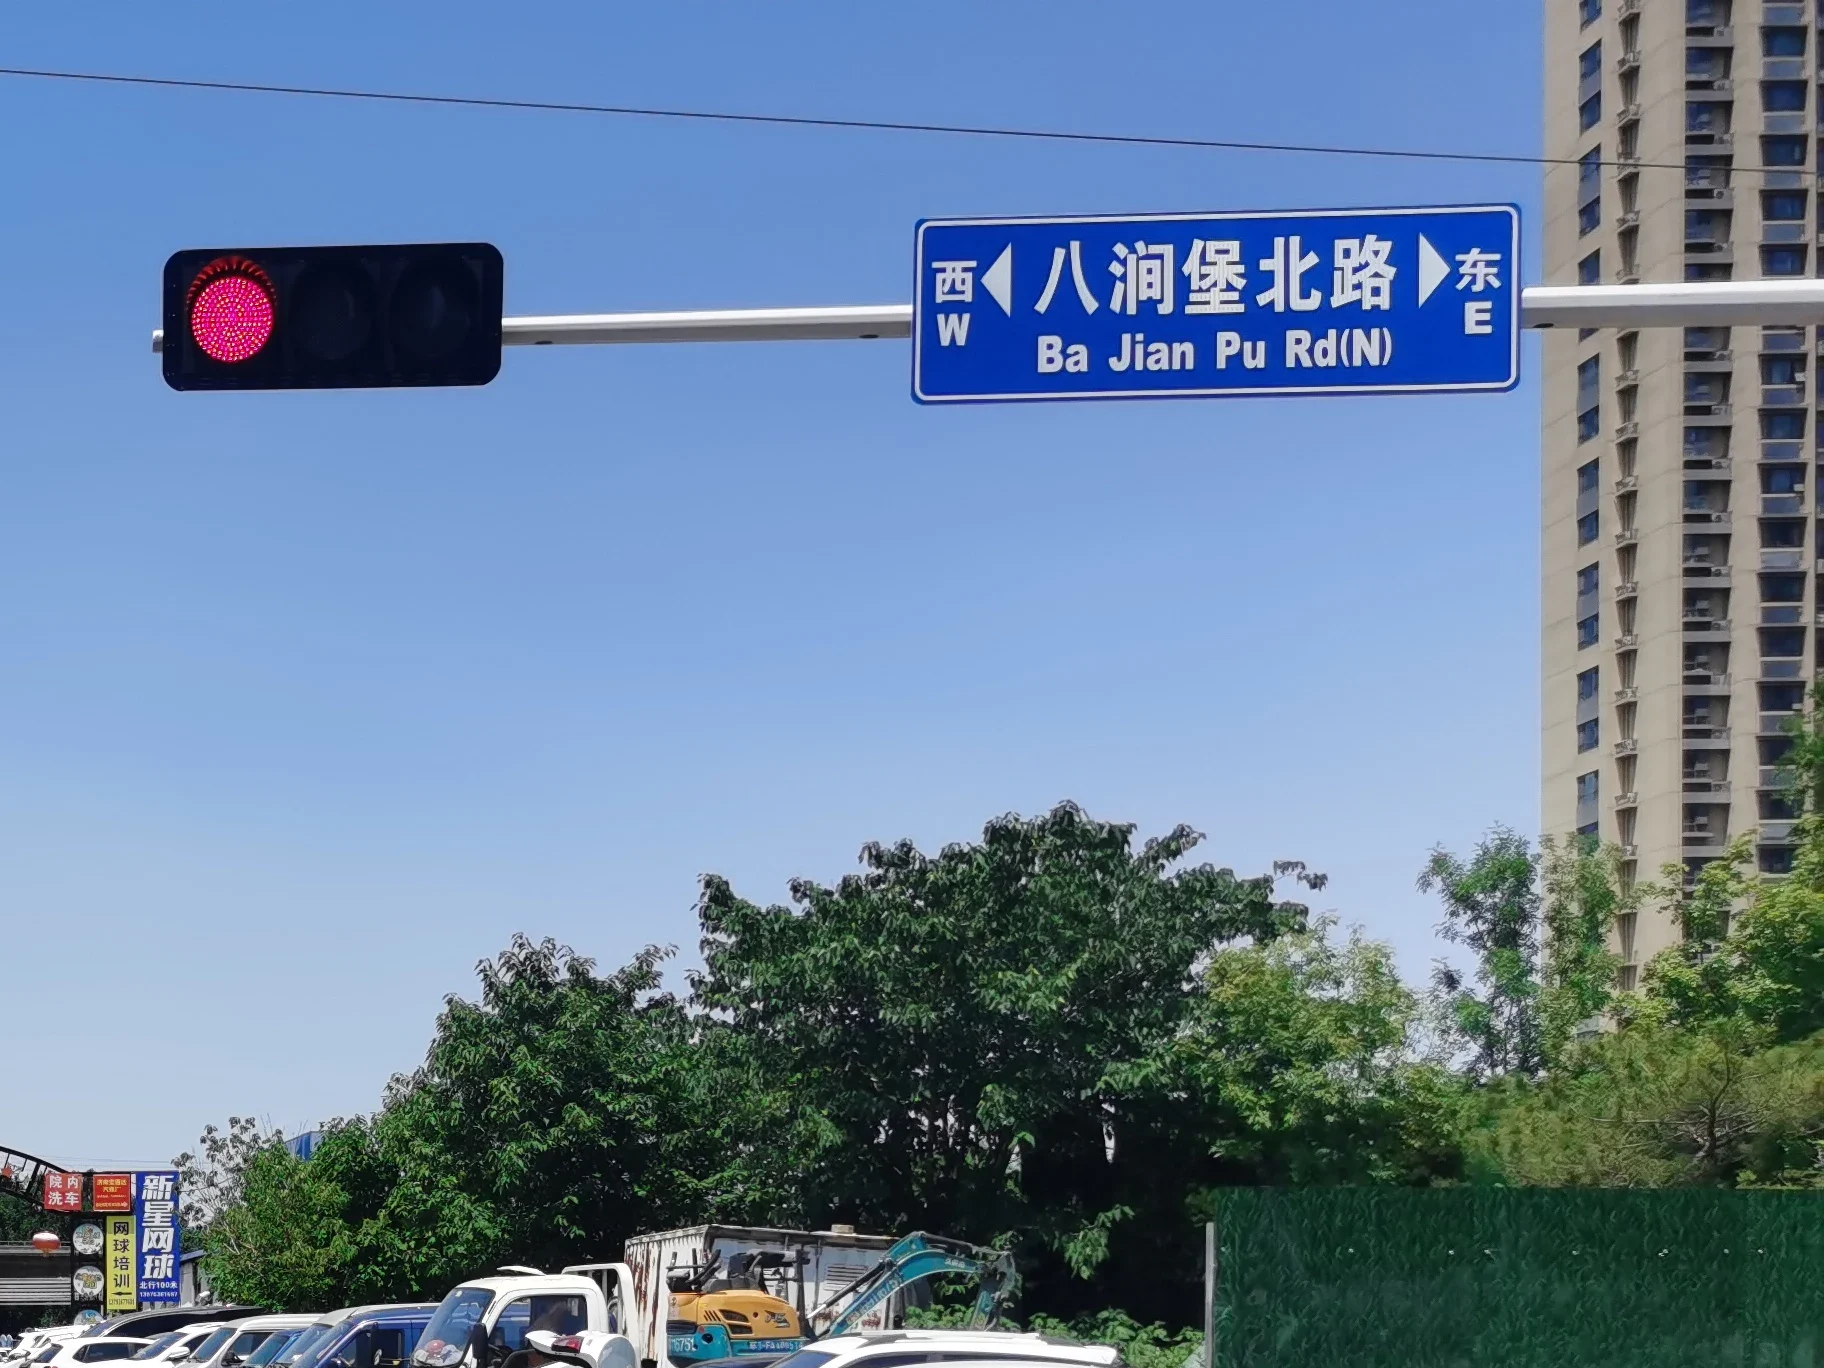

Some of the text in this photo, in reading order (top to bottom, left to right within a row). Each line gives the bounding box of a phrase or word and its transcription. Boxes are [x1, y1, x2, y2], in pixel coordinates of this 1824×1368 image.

[932, 260, 977, 303] 西
[1034, 232, 1397, 317] 八涧堡北路
[1455, 248, 1501, 293] 东
[937, 313, 970, 346] W
[1465, 302, 1492, 334] E
[1037, 328, 1392, 374] Ba Jian Pu Rd(N)
[48, 1191, 79, 1206] 洗车
[49, 1175, 78, 1189] 院内
[142, 1175, 175, 1279] 新星网球
[113, 1222, 130, 1288] 网球培训
